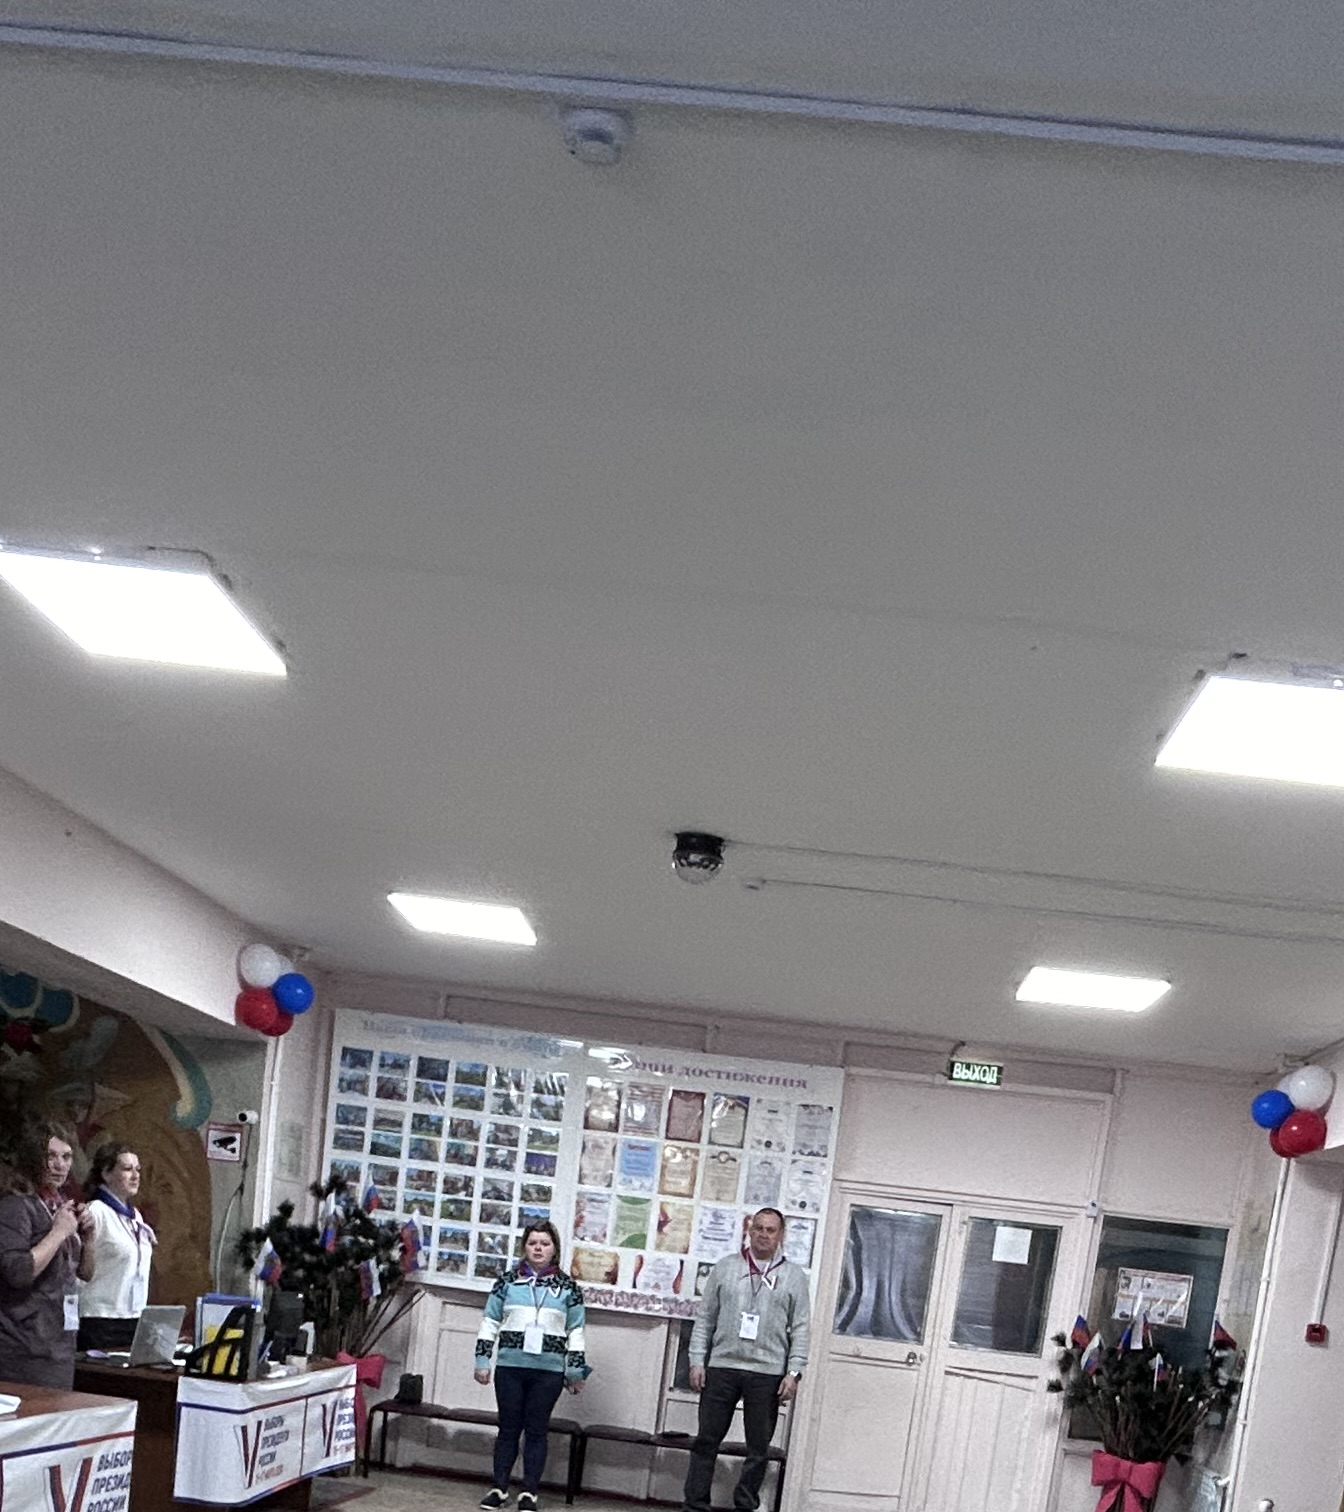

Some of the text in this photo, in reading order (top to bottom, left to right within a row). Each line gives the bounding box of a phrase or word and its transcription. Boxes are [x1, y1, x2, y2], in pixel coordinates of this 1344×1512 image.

[952, 1062, 998, 1084] ВЫХОД
[97, 1450, 134, 1473] ВЫБОР
[91, 1472, 131, 1496] ПРЕЗИД
